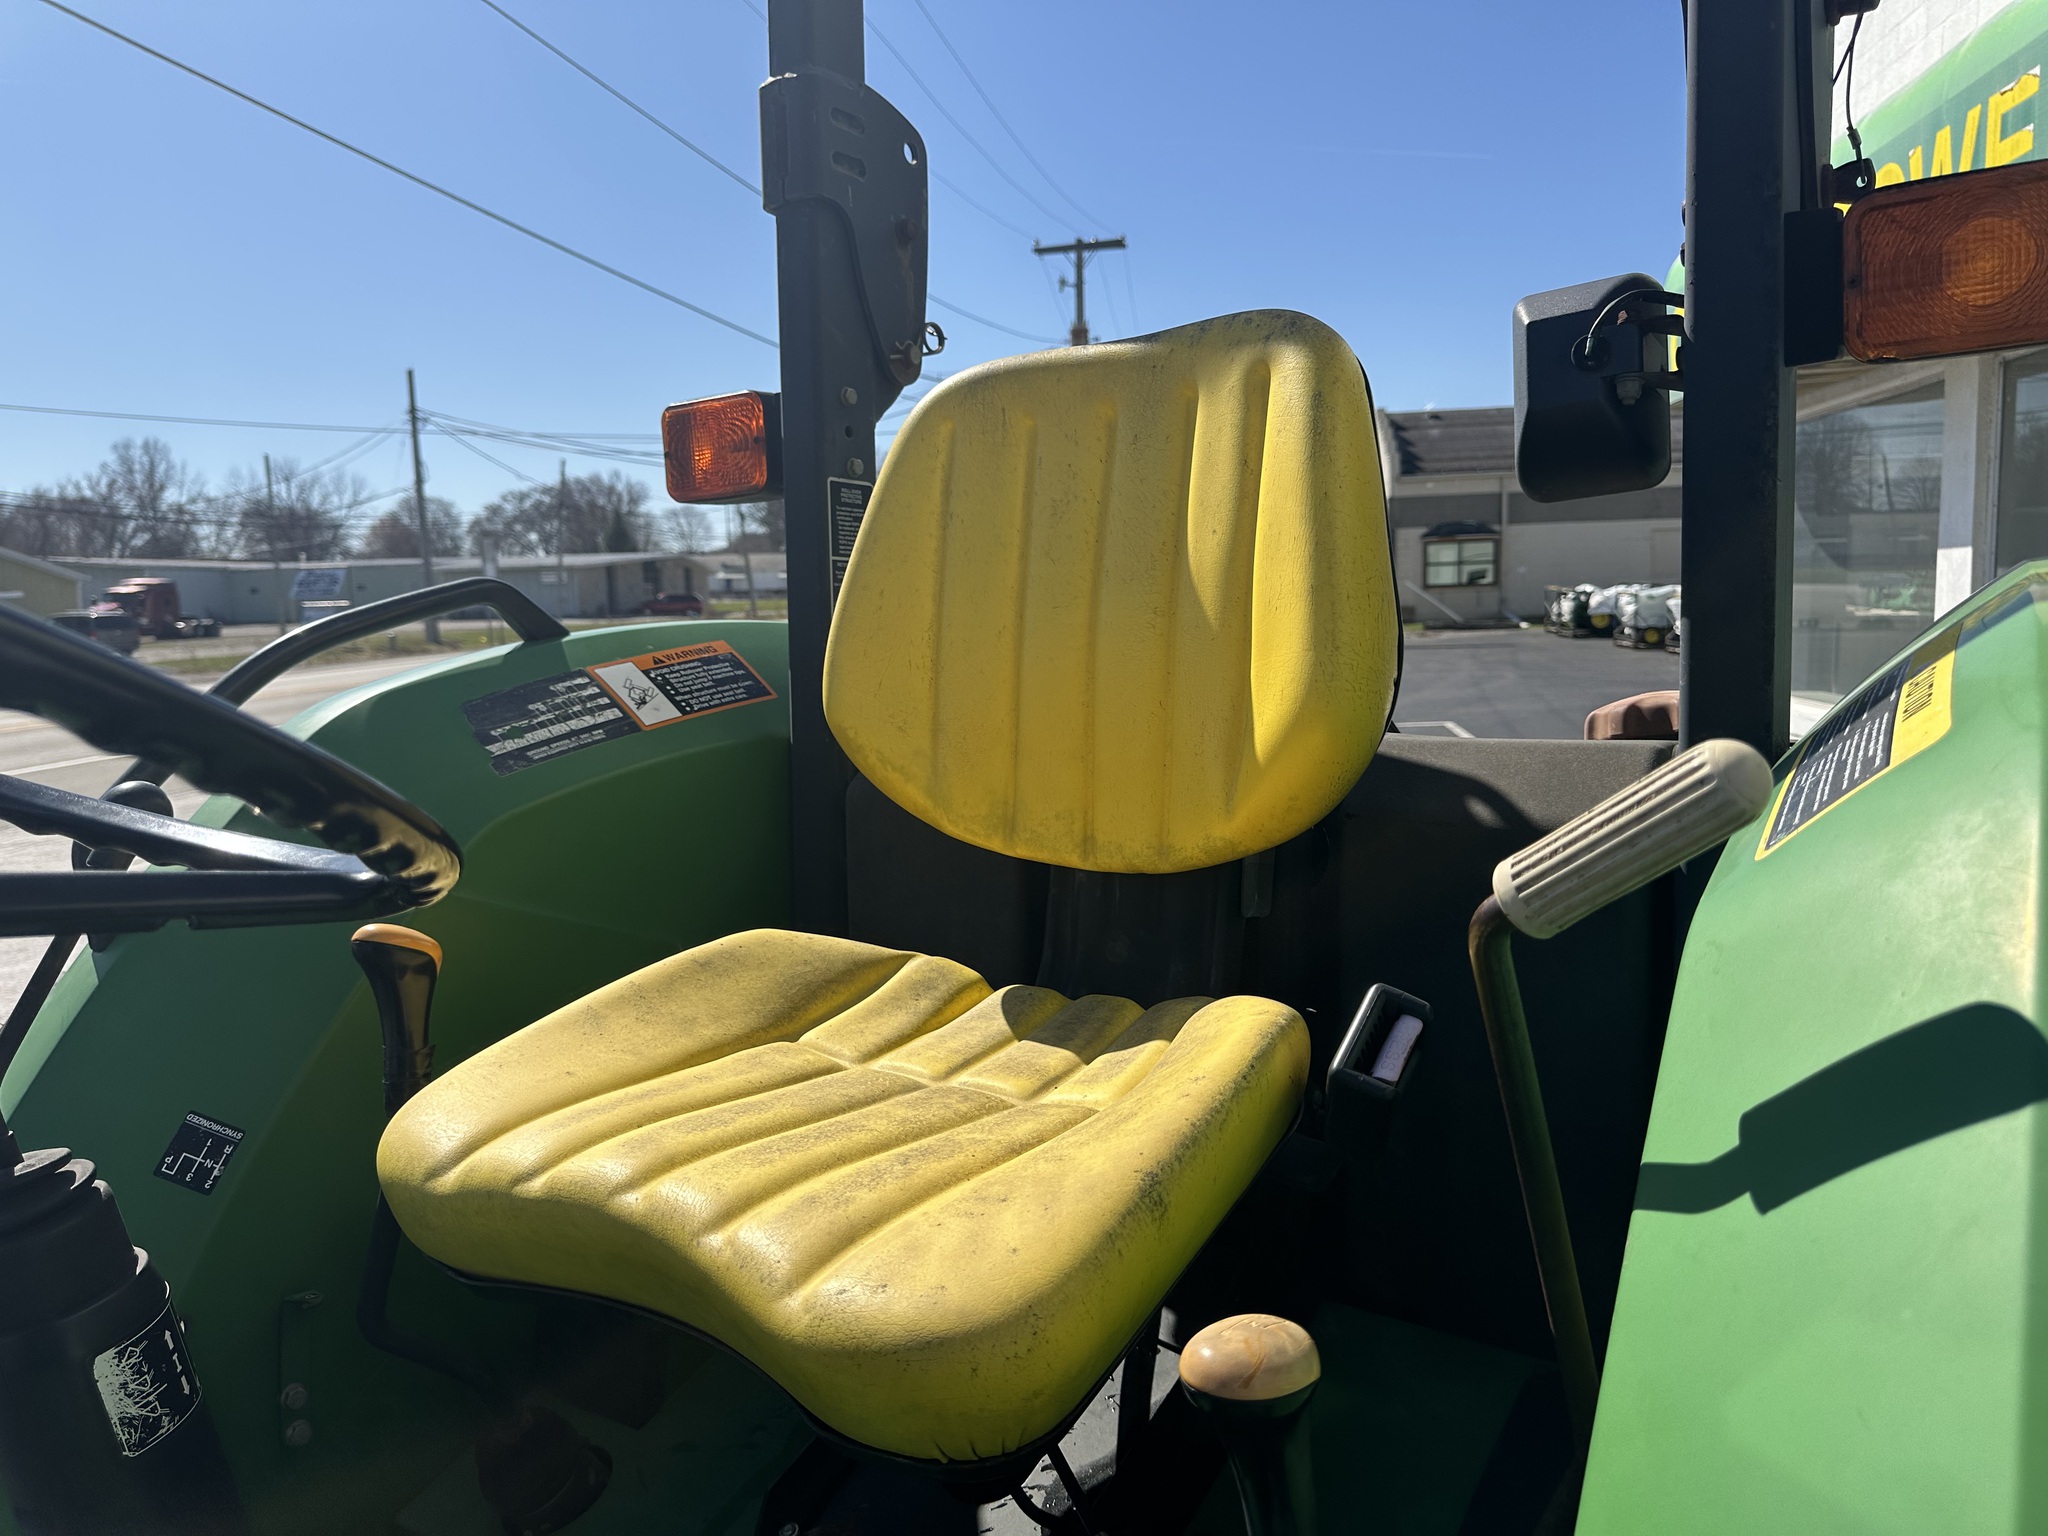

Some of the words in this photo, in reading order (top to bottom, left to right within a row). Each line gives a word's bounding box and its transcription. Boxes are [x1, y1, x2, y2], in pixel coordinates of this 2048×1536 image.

[662, 645, 718, 662] WARNING
[703, 662, 730, 670] Protective
[669, 674, 697, 683] Structure
[693, 677, 708, 685] jump
[711, 672, 735, 680] machine
[692, 688, 717, 697] structure
[1902, 665, 1937, 723] CAUTION
[186, 1112, 244, 1140] SYNCHRONIZED
[206, 1137, 213, 1147] 1
[223, 1144, 235, 1154] R
[164, 1155, 174, 1164] P
[204, 1158, 214, 1169] N
[185, 1172, 194, 1182] 3
[204, 1179, 214, 1189] 2
